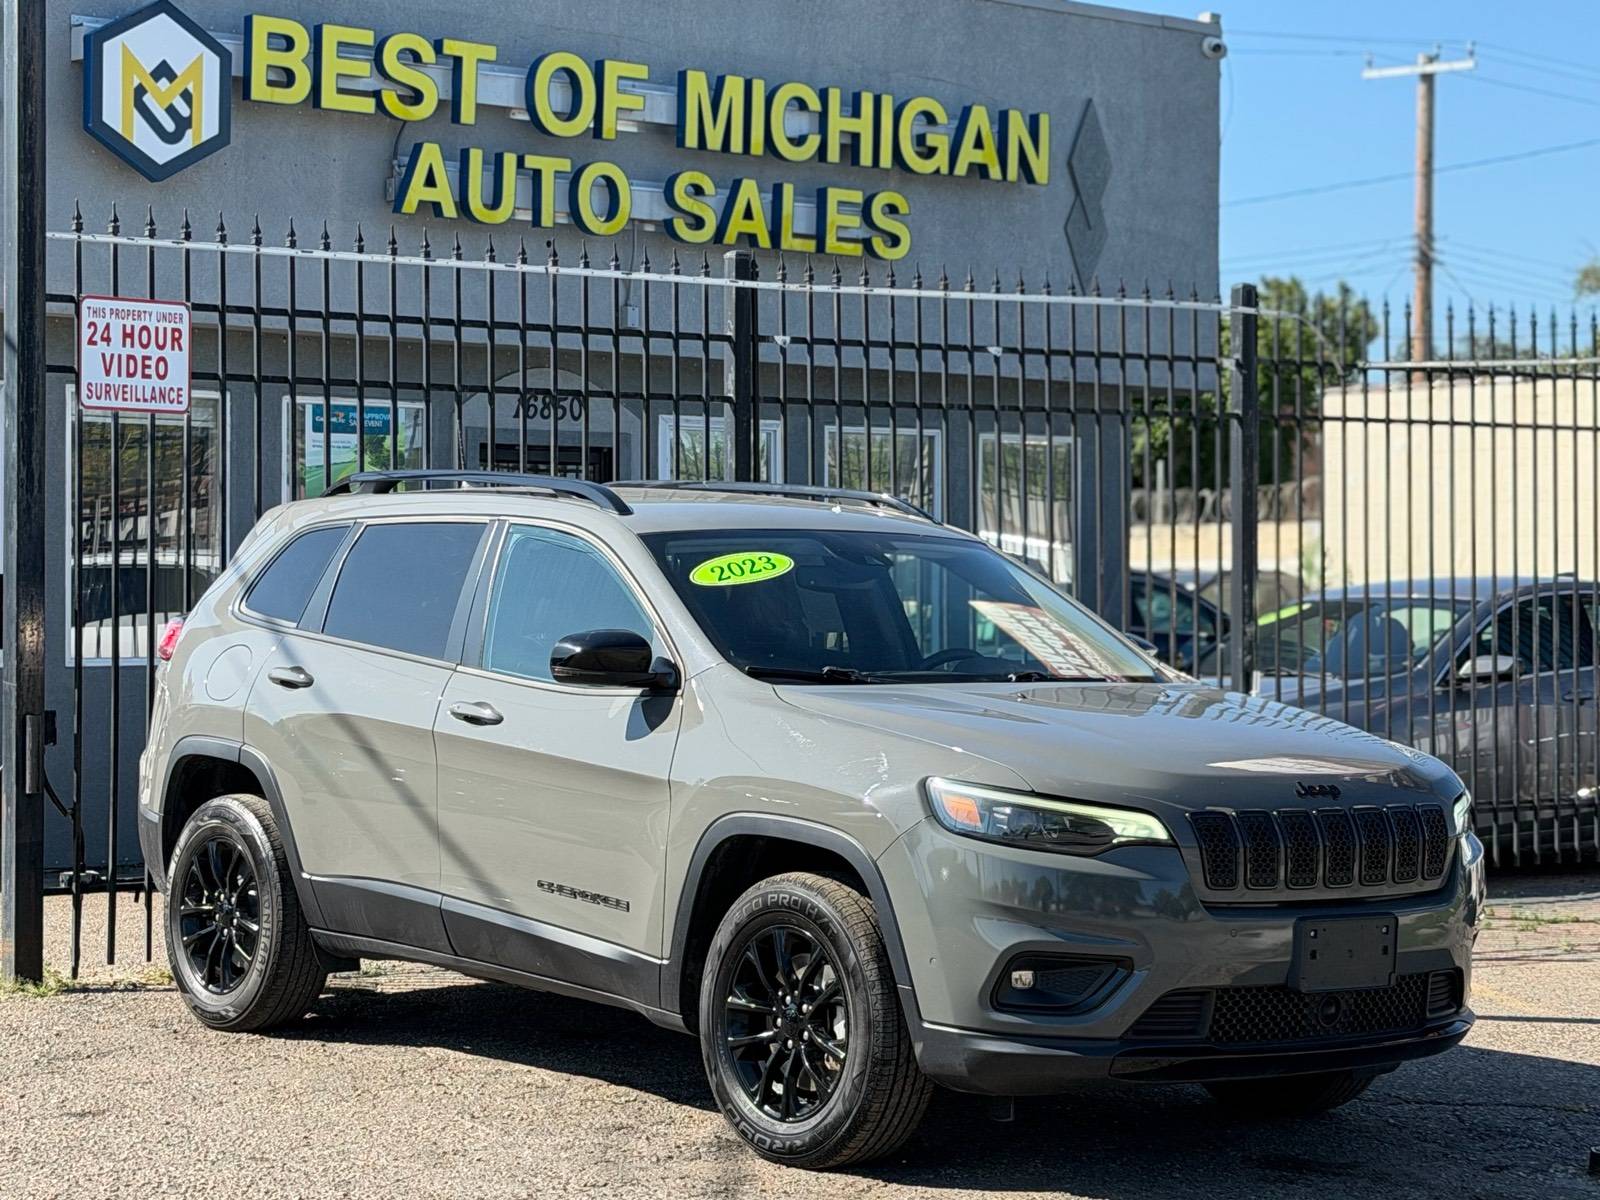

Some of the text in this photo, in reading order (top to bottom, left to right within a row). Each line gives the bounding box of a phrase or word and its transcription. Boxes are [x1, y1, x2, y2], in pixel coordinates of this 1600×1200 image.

[245, 14, 1050, 185] BEST OF MICHIGAN
[395, 142, 911, 260] AUTO SALES
[87, 306, 184, 324] THIS PROPERTY UNDER
[86, 321, 183, 352] 24 HOUR
[101, 352, 168, 381] VIDEO
[86, 382, 183, 405] SURVEILLANCE
[512, 394, 583, 421] 16850
[364, 420, 383, 428] EVENT
[710, 556, 777, 582] 2023
[1295, 781, 1342, 800] Jeep
[537, 880, 630, 912] CHEROKEE
[767, 893, 802, 910] PRO
